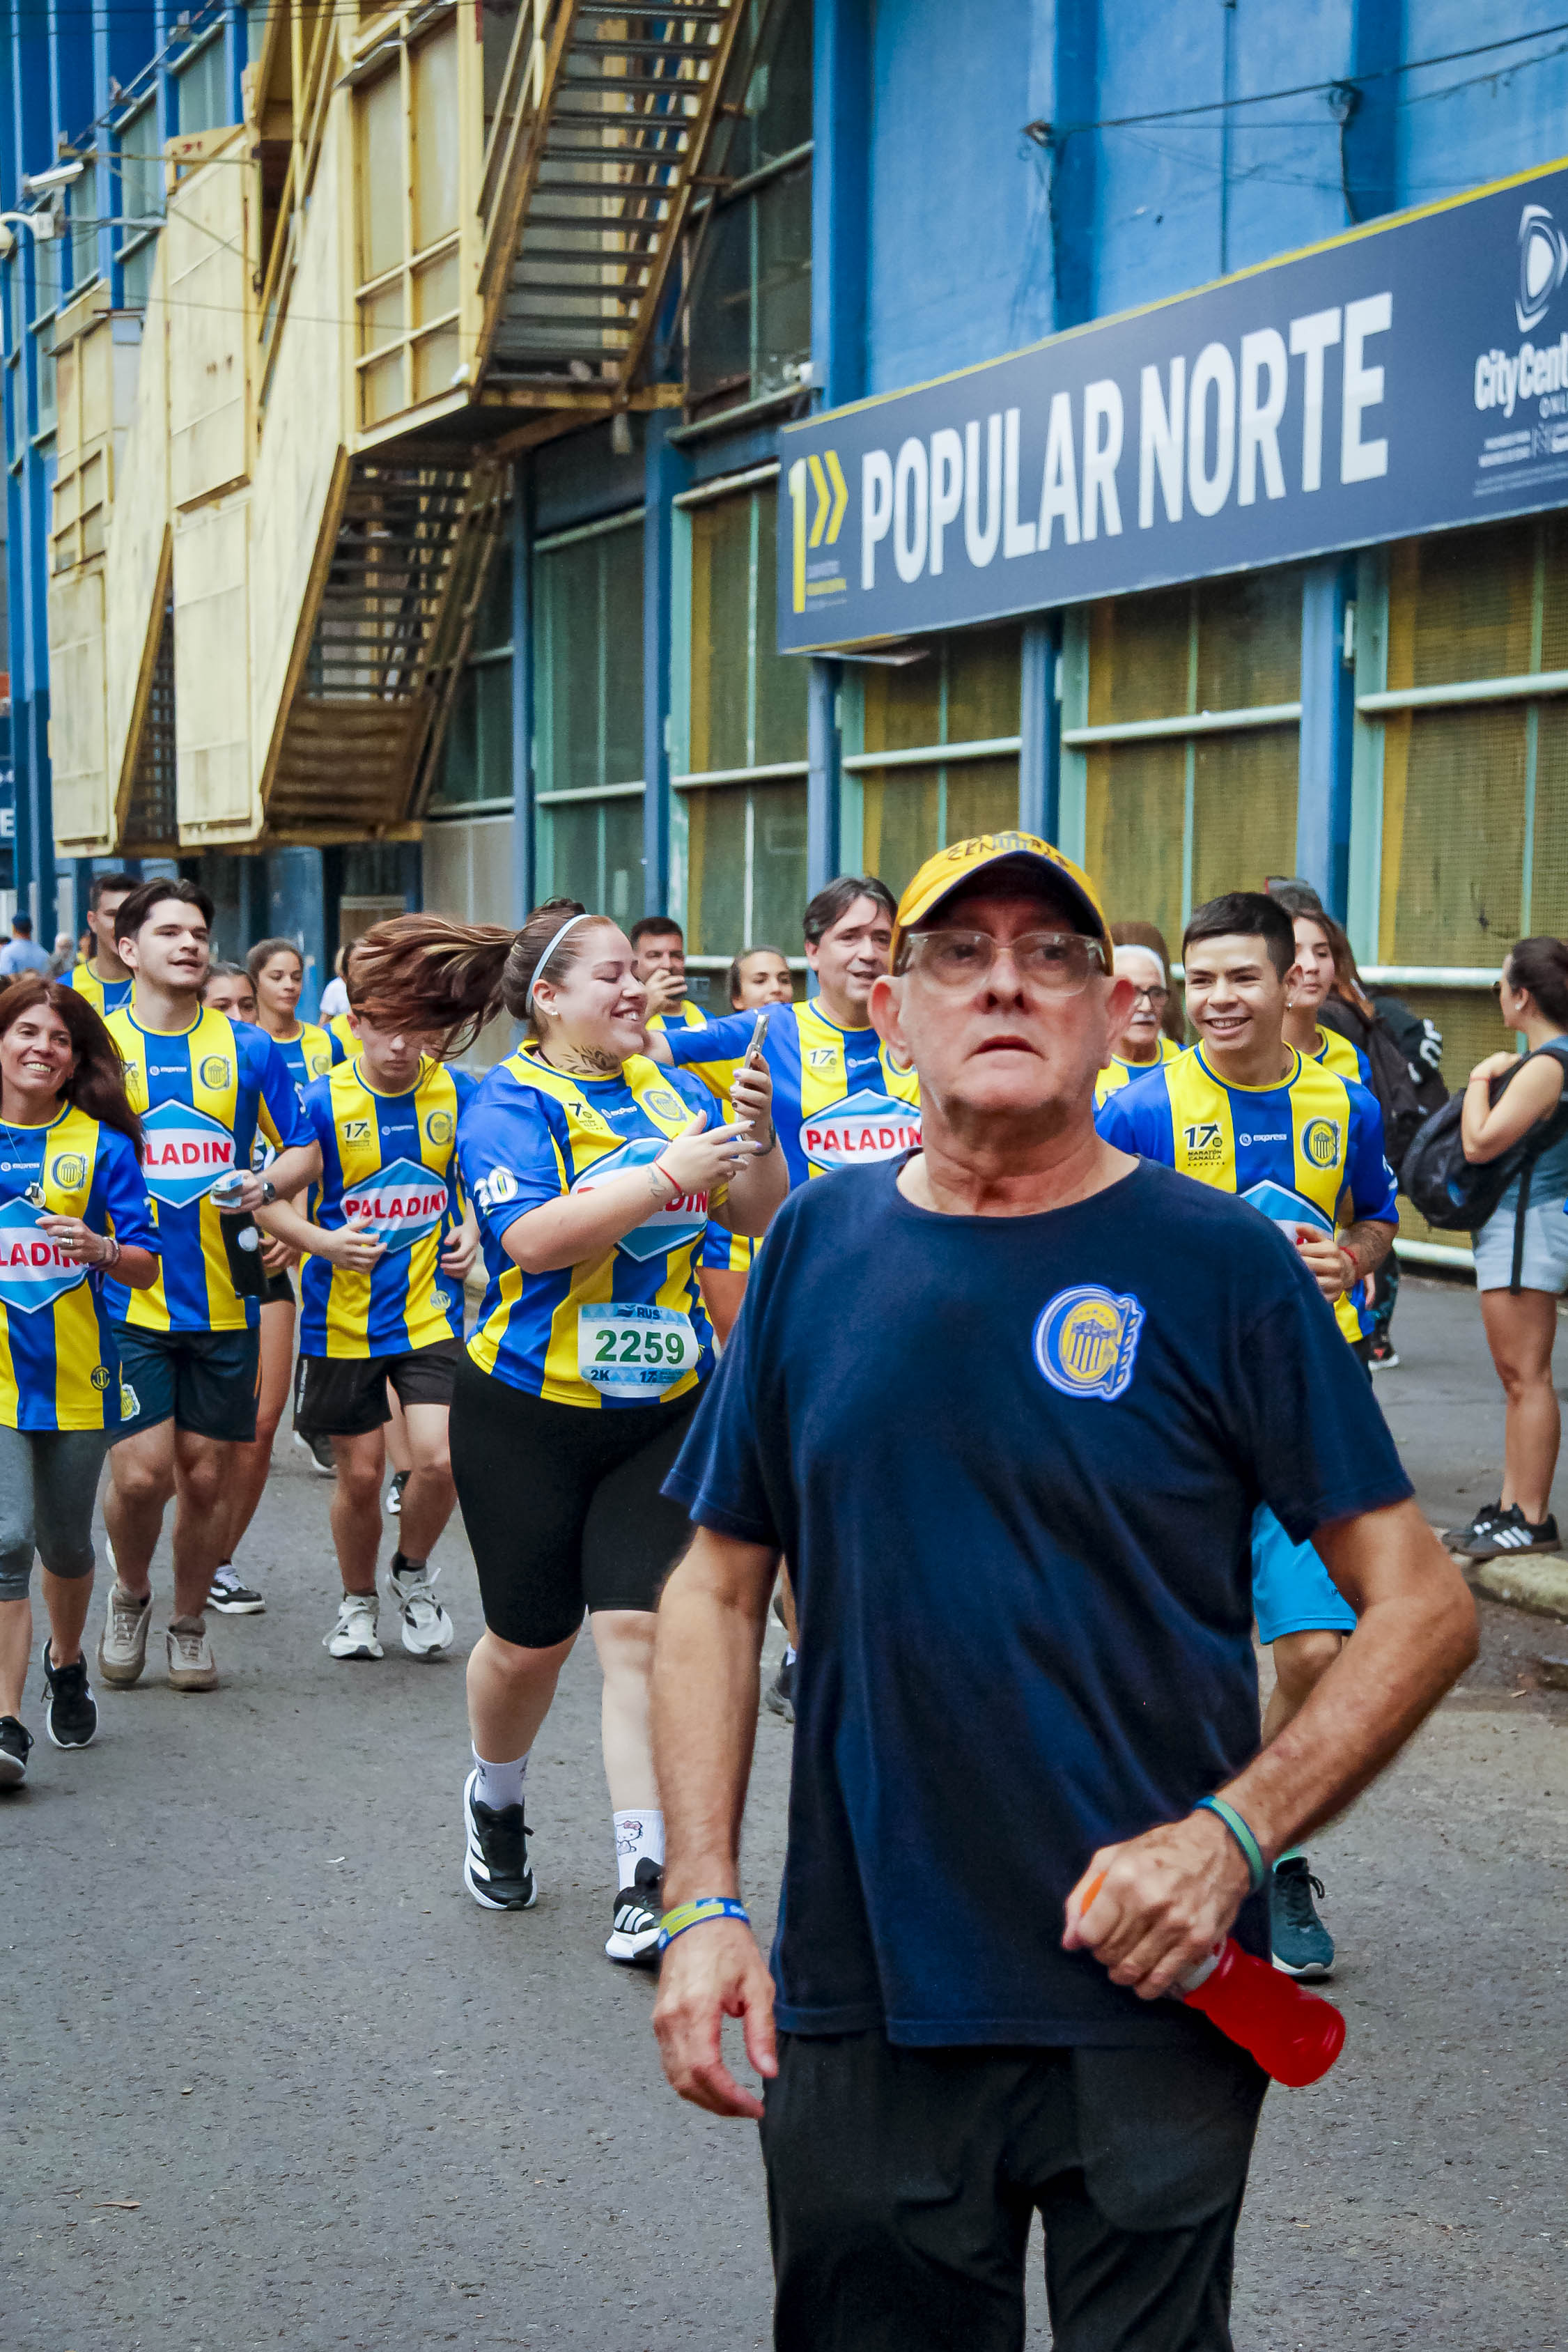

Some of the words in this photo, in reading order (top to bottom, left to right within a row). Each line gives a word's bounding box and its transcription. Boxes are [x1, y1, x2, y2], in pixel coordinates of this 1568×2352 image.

[860, 378, 1124, 591] POPULAR
[1138, 291, 1392, 529] NORTE
[809, 1049, 835, 1065] 17
[344, 1122, 368, 1138] 17
[1184, 1124, 1219, 1149] 17
[1253, 1133, 1287, 1143] express
[144, 1141, 232, 1166] LADIN
[637, 1307, 660, 1320] RUS
[595, 1329, 685, 1365] 2259
[590, 1370, 610, 1382] 2K
